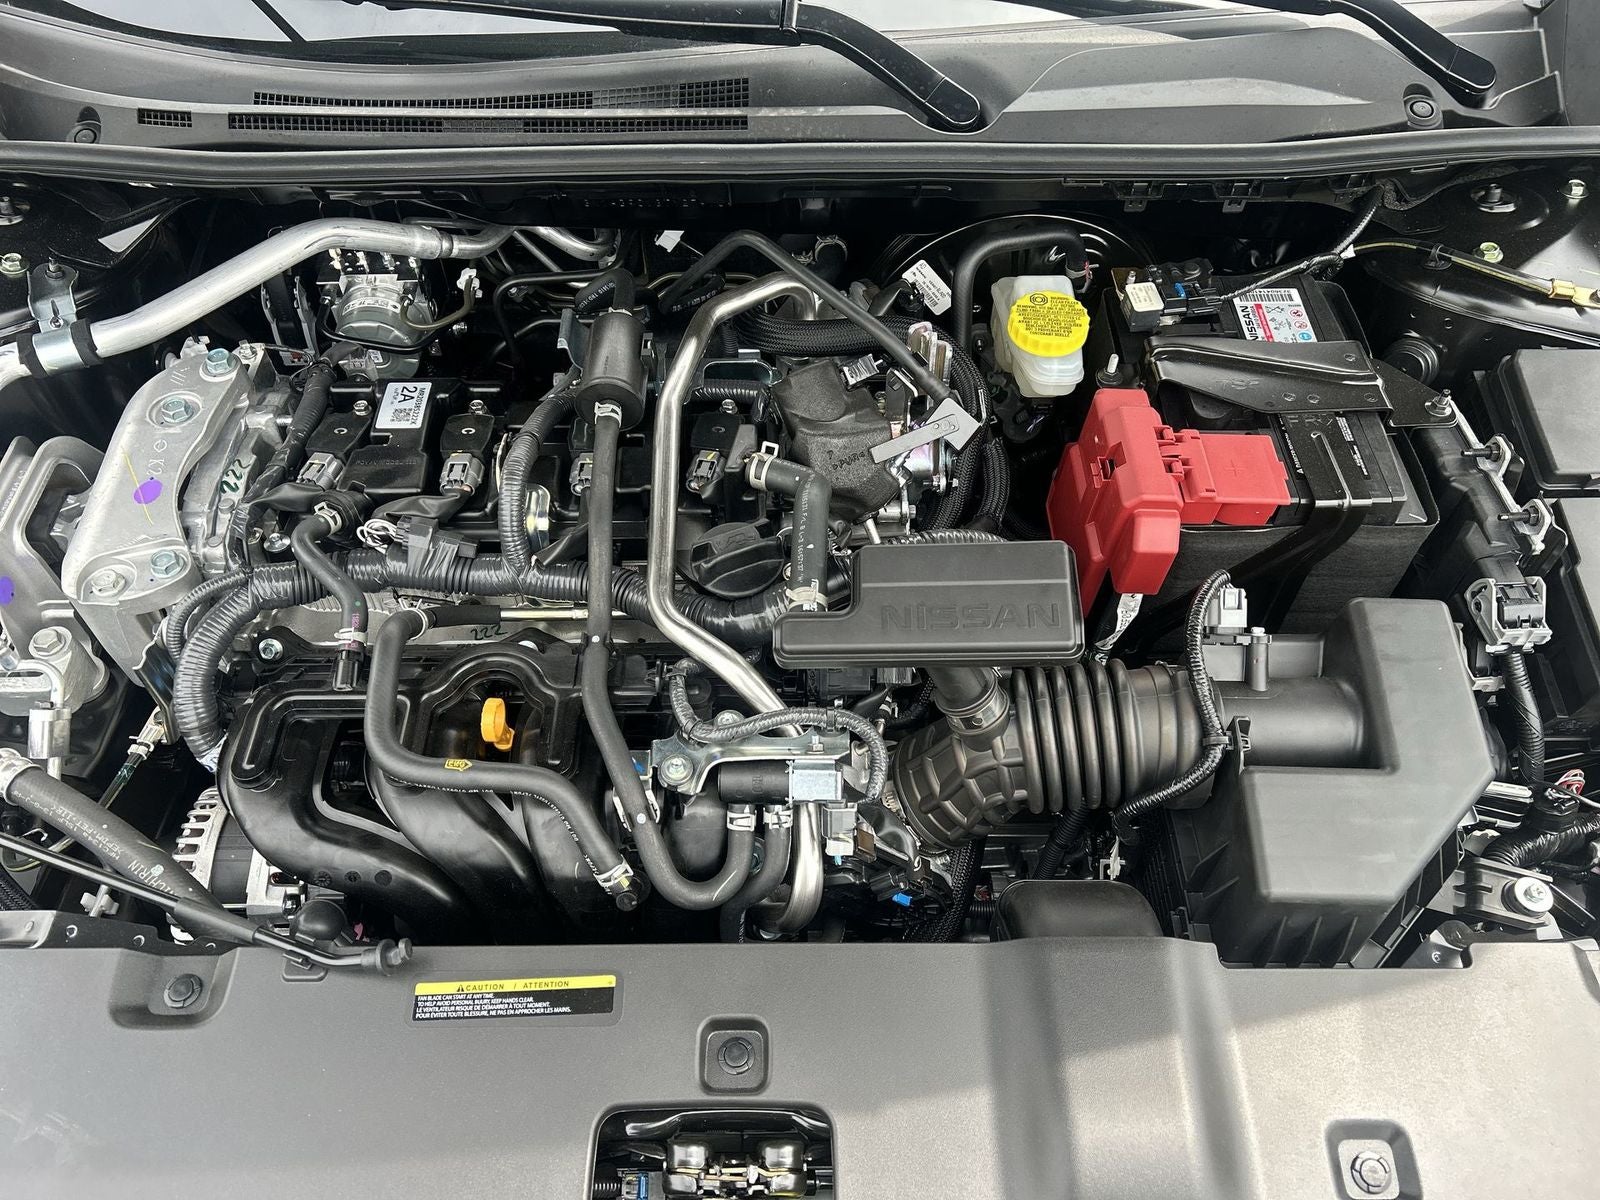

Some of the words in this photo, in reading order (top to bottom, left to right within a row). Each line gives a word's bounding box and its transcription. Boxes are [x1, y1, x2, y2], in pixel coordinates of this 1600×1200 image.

[1240, 305, 1259, 341] NISSAN
[398, 386, 417, 403] 2A
[220, 458, 251, 494] 222
[880, 603, 1060, 630] NISSAN
